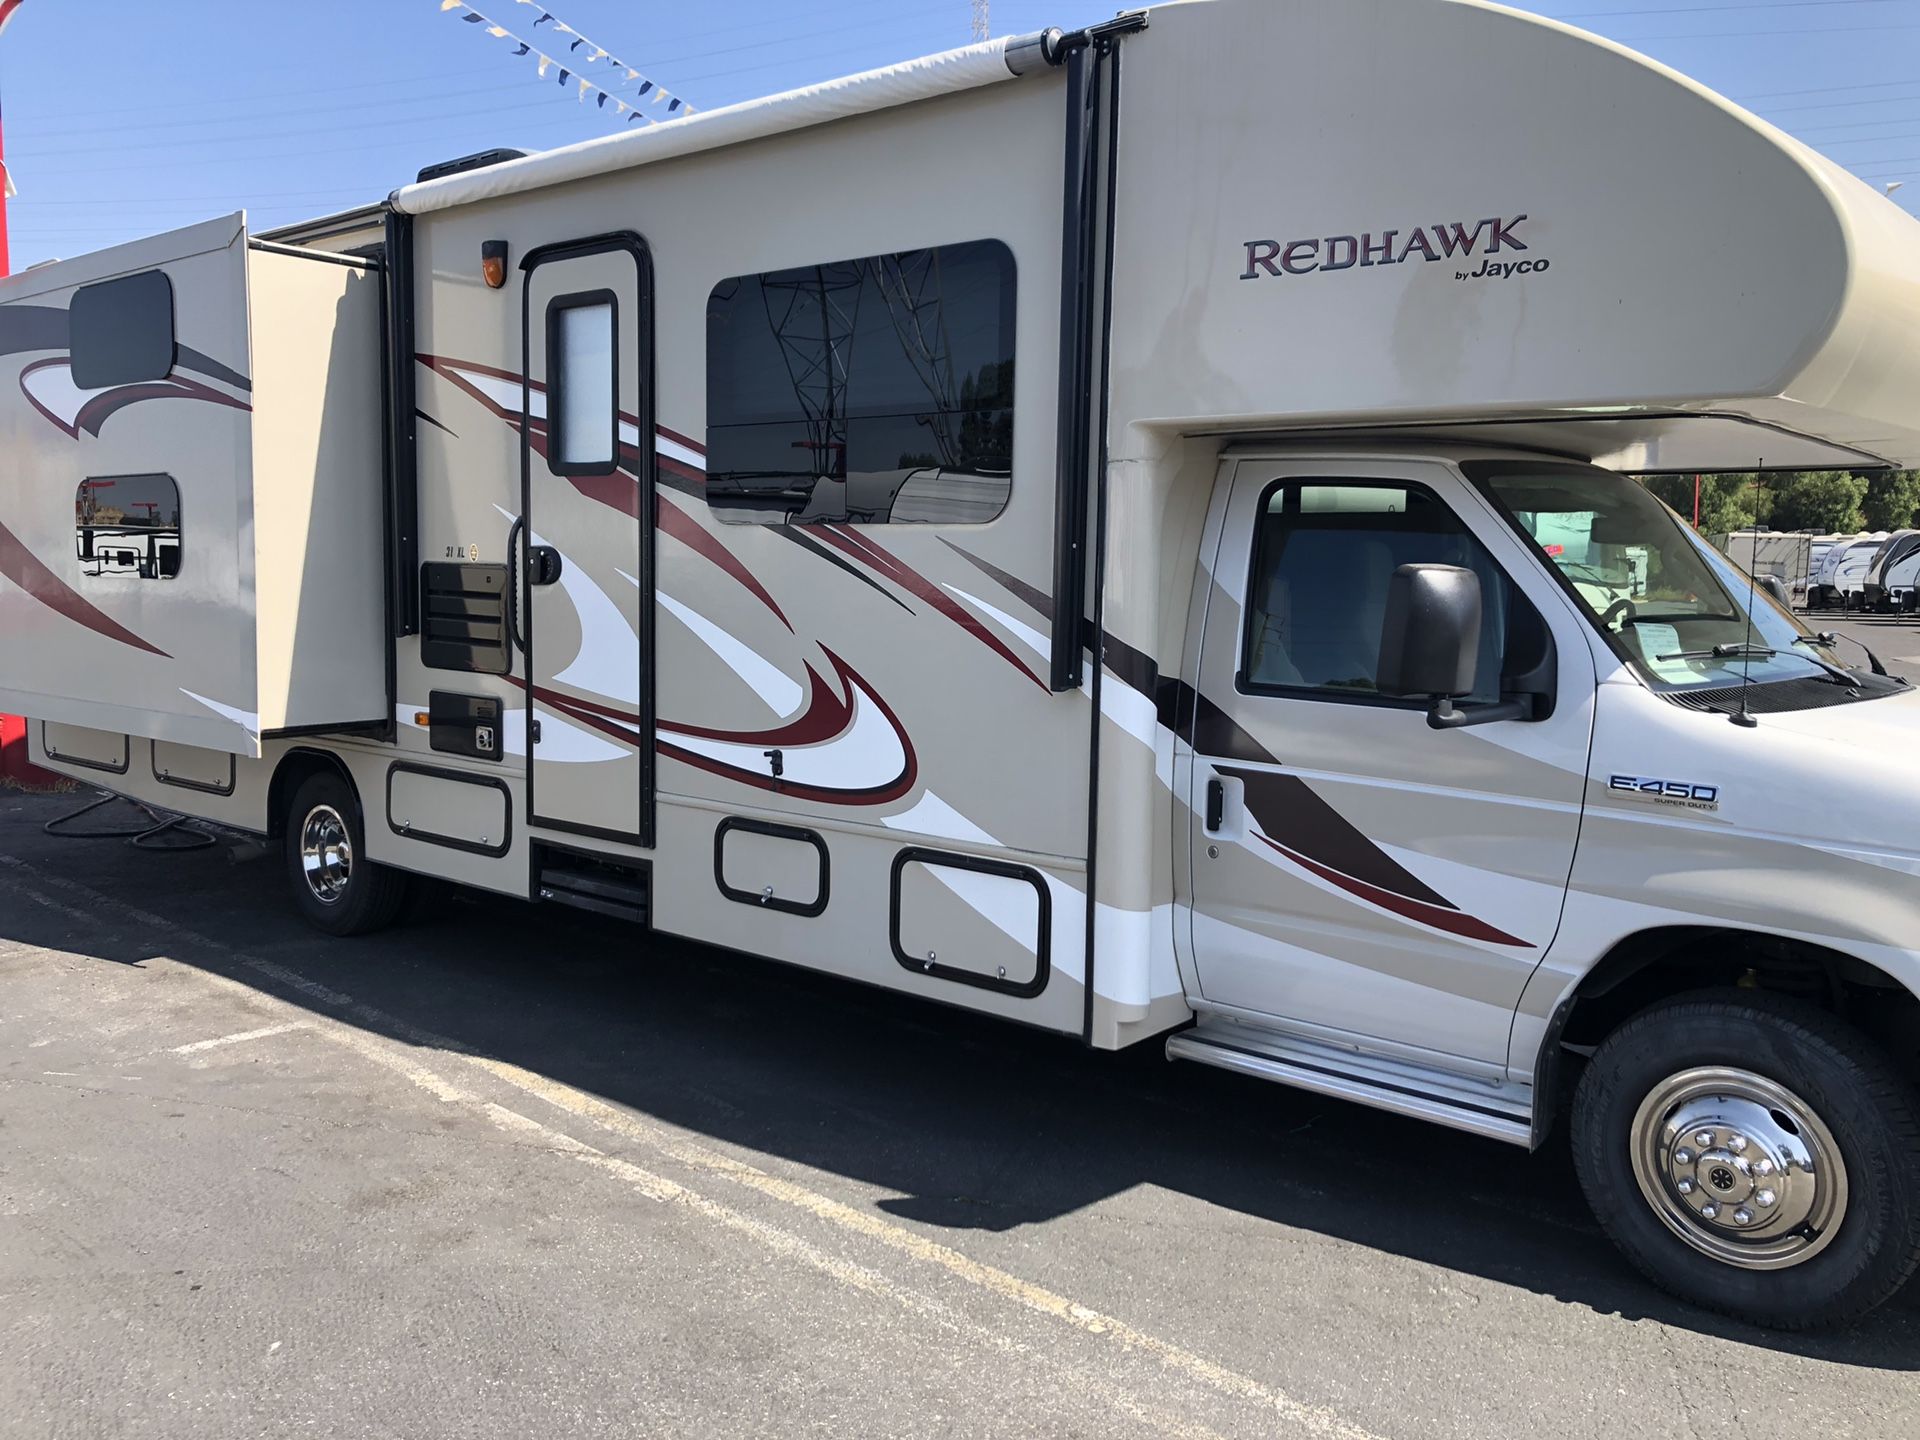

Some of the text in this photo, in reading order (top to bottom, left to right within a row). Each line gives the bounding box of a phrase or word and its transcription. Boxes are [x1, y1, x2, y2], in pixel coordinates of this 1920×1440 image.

[1239, 214, 1528, 280] REDHAWK
[1455, 259, 1550, 281] by Jayco
[1609, 775, 1718, 802] E-450
[1654, 797, 1715, 810] SUPER DUTY
